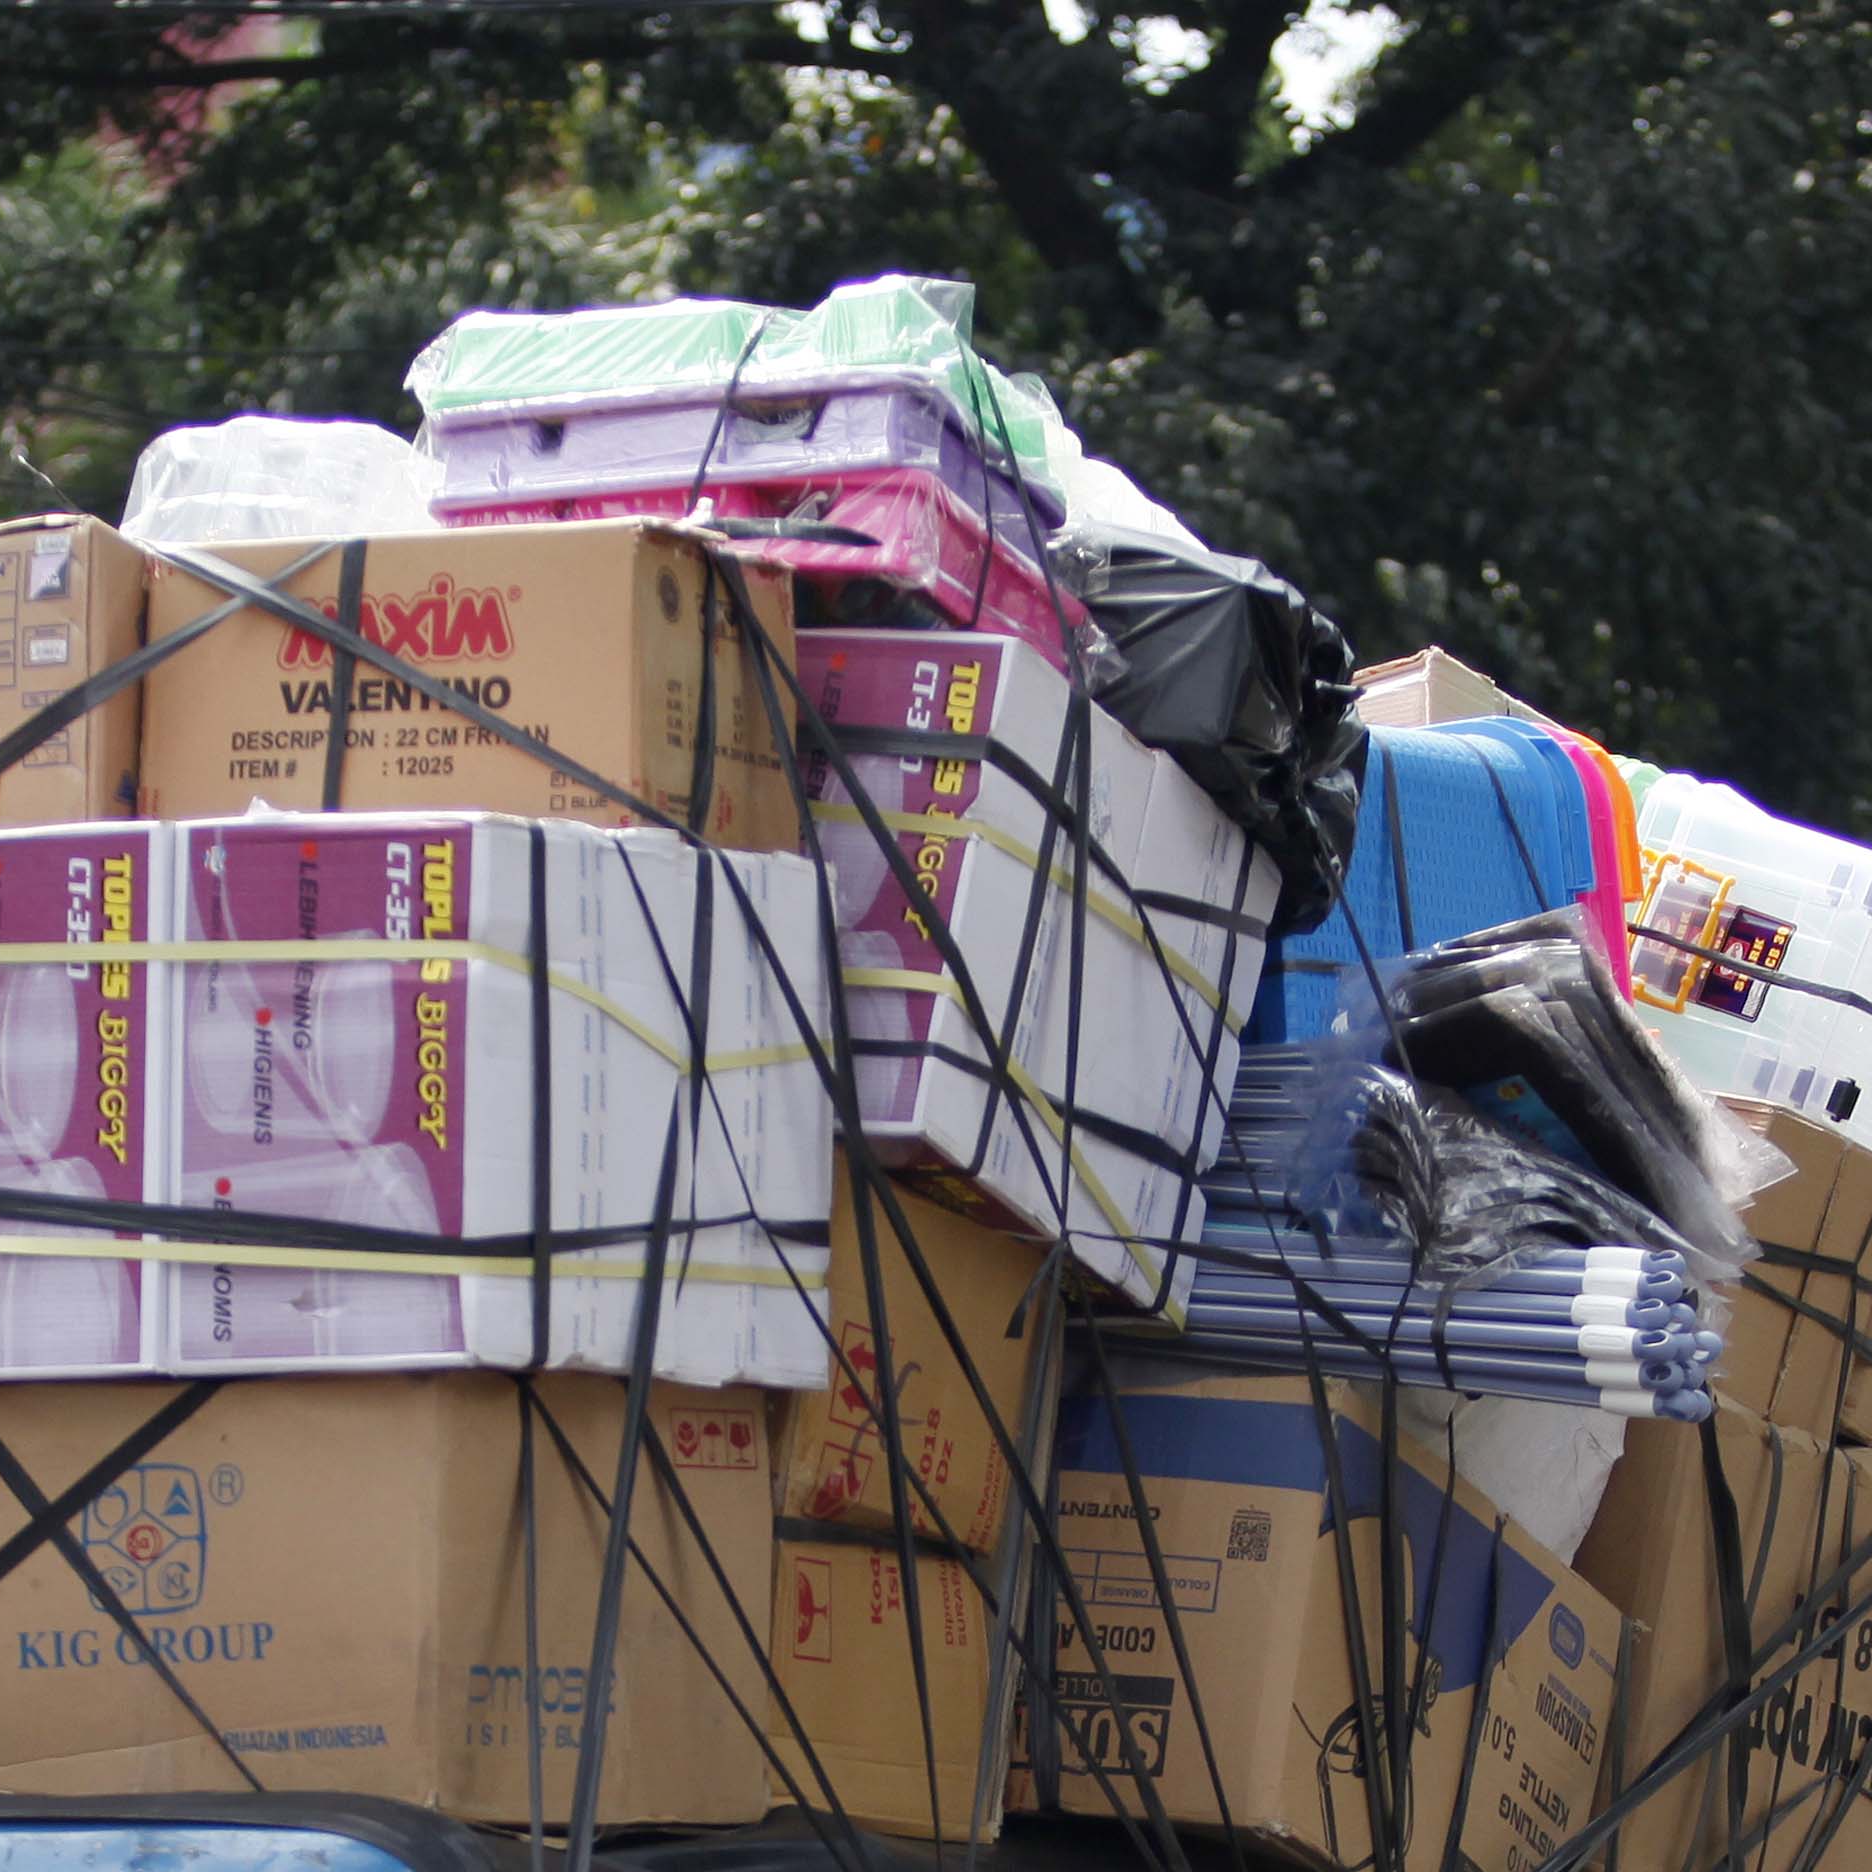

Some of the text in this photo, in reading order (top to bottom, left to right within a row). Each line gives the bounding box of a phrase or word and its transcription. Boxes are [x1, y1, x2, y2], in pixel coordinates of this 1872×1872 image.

[280, 674, 512, 715] VAENTINO
[231, 729, 375, 751] DESCRIPON
[395, 727, 419, 748] 22
[425, 725, 458, 747] CM
[932, 661, 982, 796] TOPES
[229, 759, 279, 780] ITEM
[395, 756, 454, 777] 12025
[385, 841, 413, 963] CT-35
[1765, 925, 1791, 968] CB 30
[292, 959, 315, 1051] ENING
[415, 837, 455, 1151] TOPLS BIGGY
[97, 1008, 129, 1165] BIGGY
[253, 1026, 275, 1146] HIGIENIS
[1167, 1577, 1212, 1592] COLOU
[16, 1621, 274, 1670] KIG GROUP
[1096, 1624, 1157, 1653] CODE
[294, 1724, 388, 1750] INDONESIA
[1491, 1714, 1518, 1762] 5.0
[1534, 1681, 1585, 1753] MASPION
[1518, 1761, 1571, 1827] KETTLE
[1498, 1792, 1558, 1857] ISTLING
